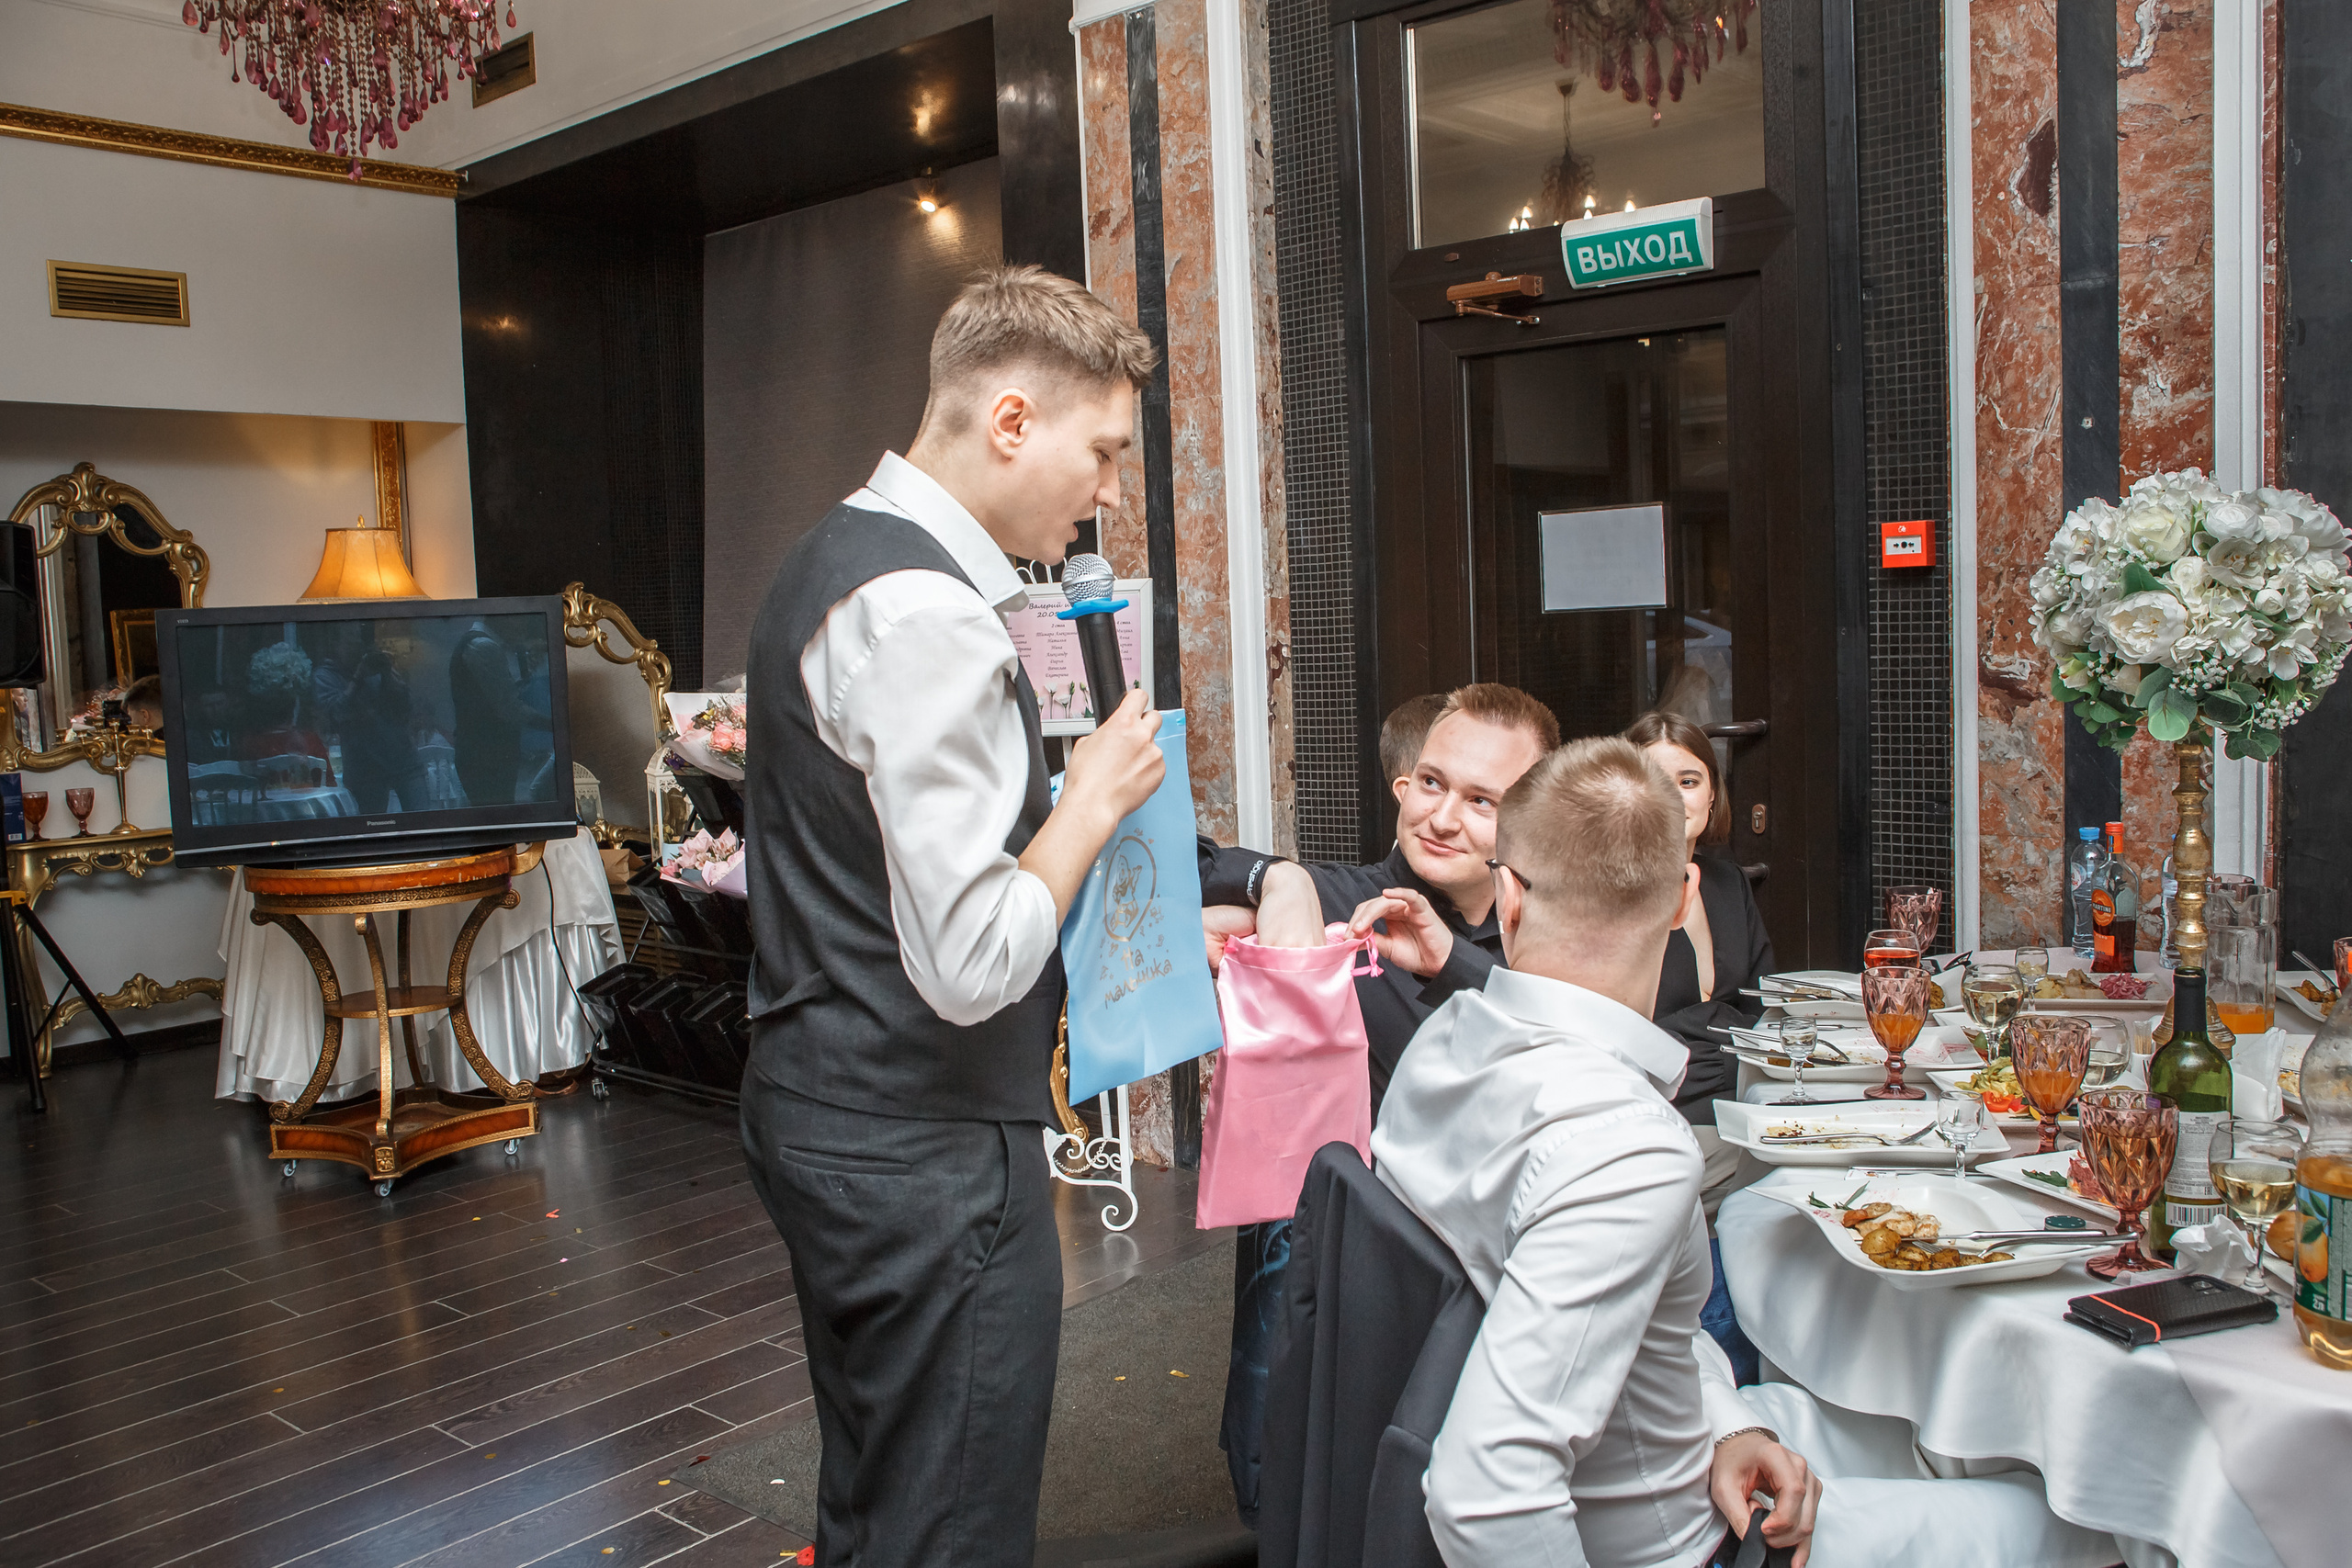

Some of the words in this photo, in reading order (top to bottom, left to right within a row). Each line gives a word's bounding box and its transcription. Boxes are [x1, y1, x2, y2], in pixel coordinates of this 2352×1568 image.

[1577, 231, 1693, 274] ВЫХОД
[1028, 602, 1064, 611] Валерий
[2092, 902, 2111, 914] MARTINI
